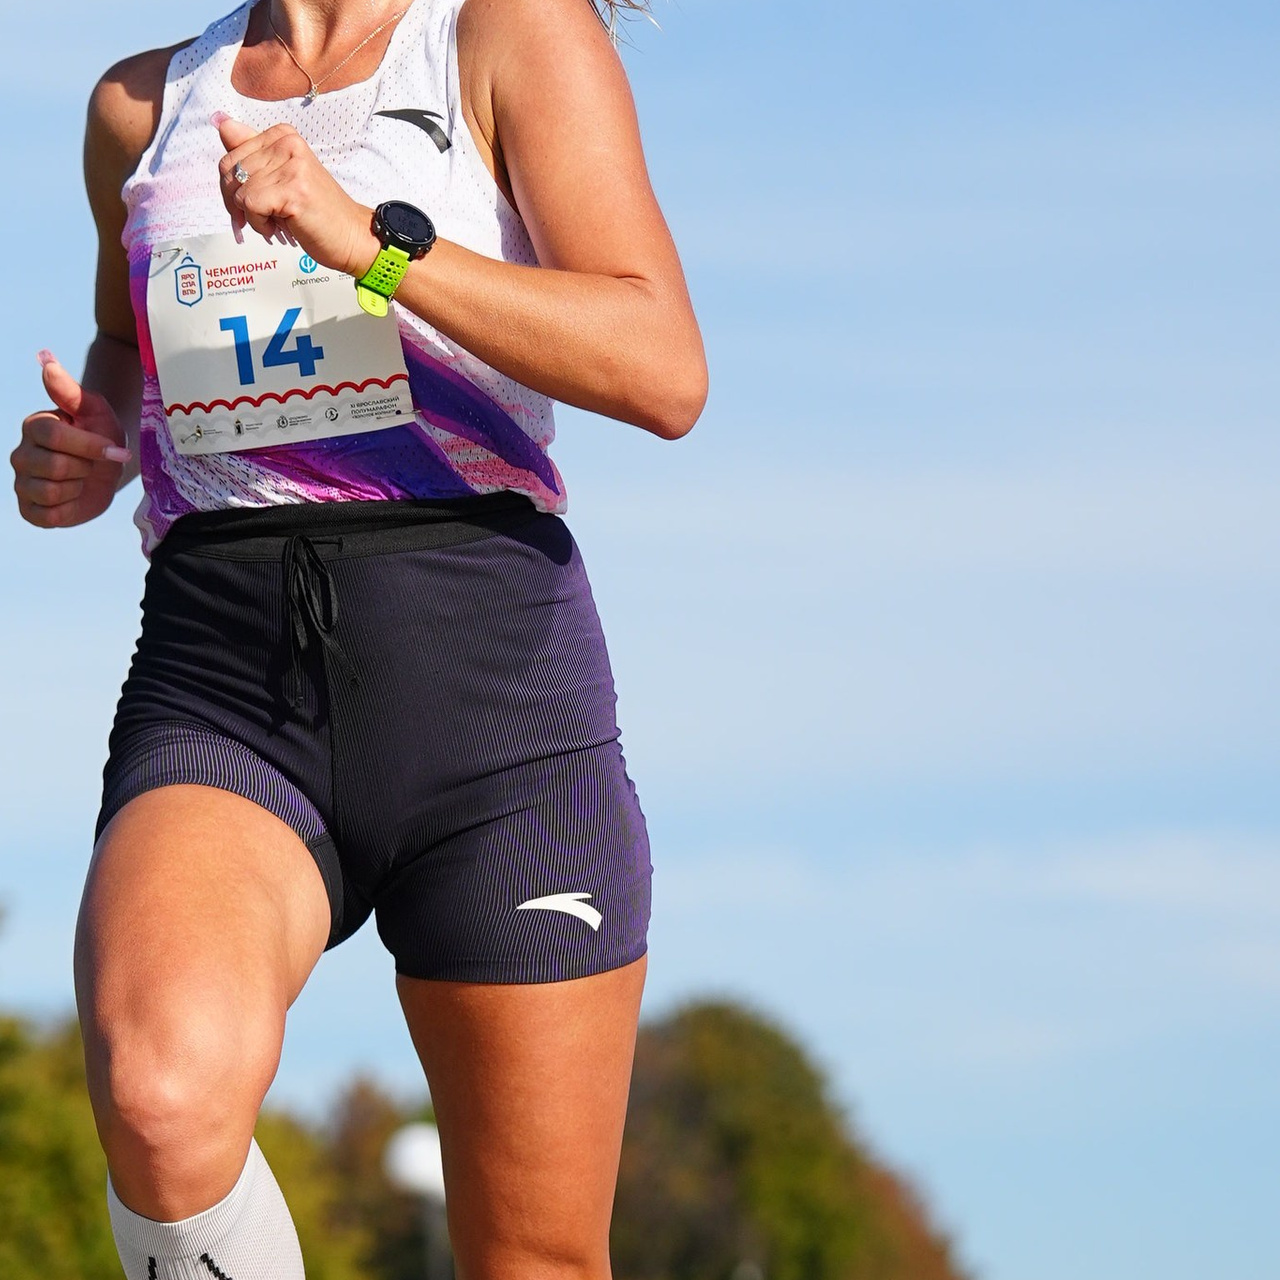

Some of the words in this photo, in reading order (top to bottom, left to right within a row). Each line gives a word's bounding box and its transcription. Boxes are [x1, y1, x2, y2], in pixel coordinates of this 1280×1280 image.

[205, 260, 278, 278] ЧЕМПИОНАТ
[207, 275, 254, 290] РОССИИ
[291, 275, 330, 288] pharmeco
[219, 307, 324, 385] 14
[356, 395, 400, 408] ЯРОСЛАВСКИЙ
[350, 403, 397, 415] ПОЛУМАРАФОН
